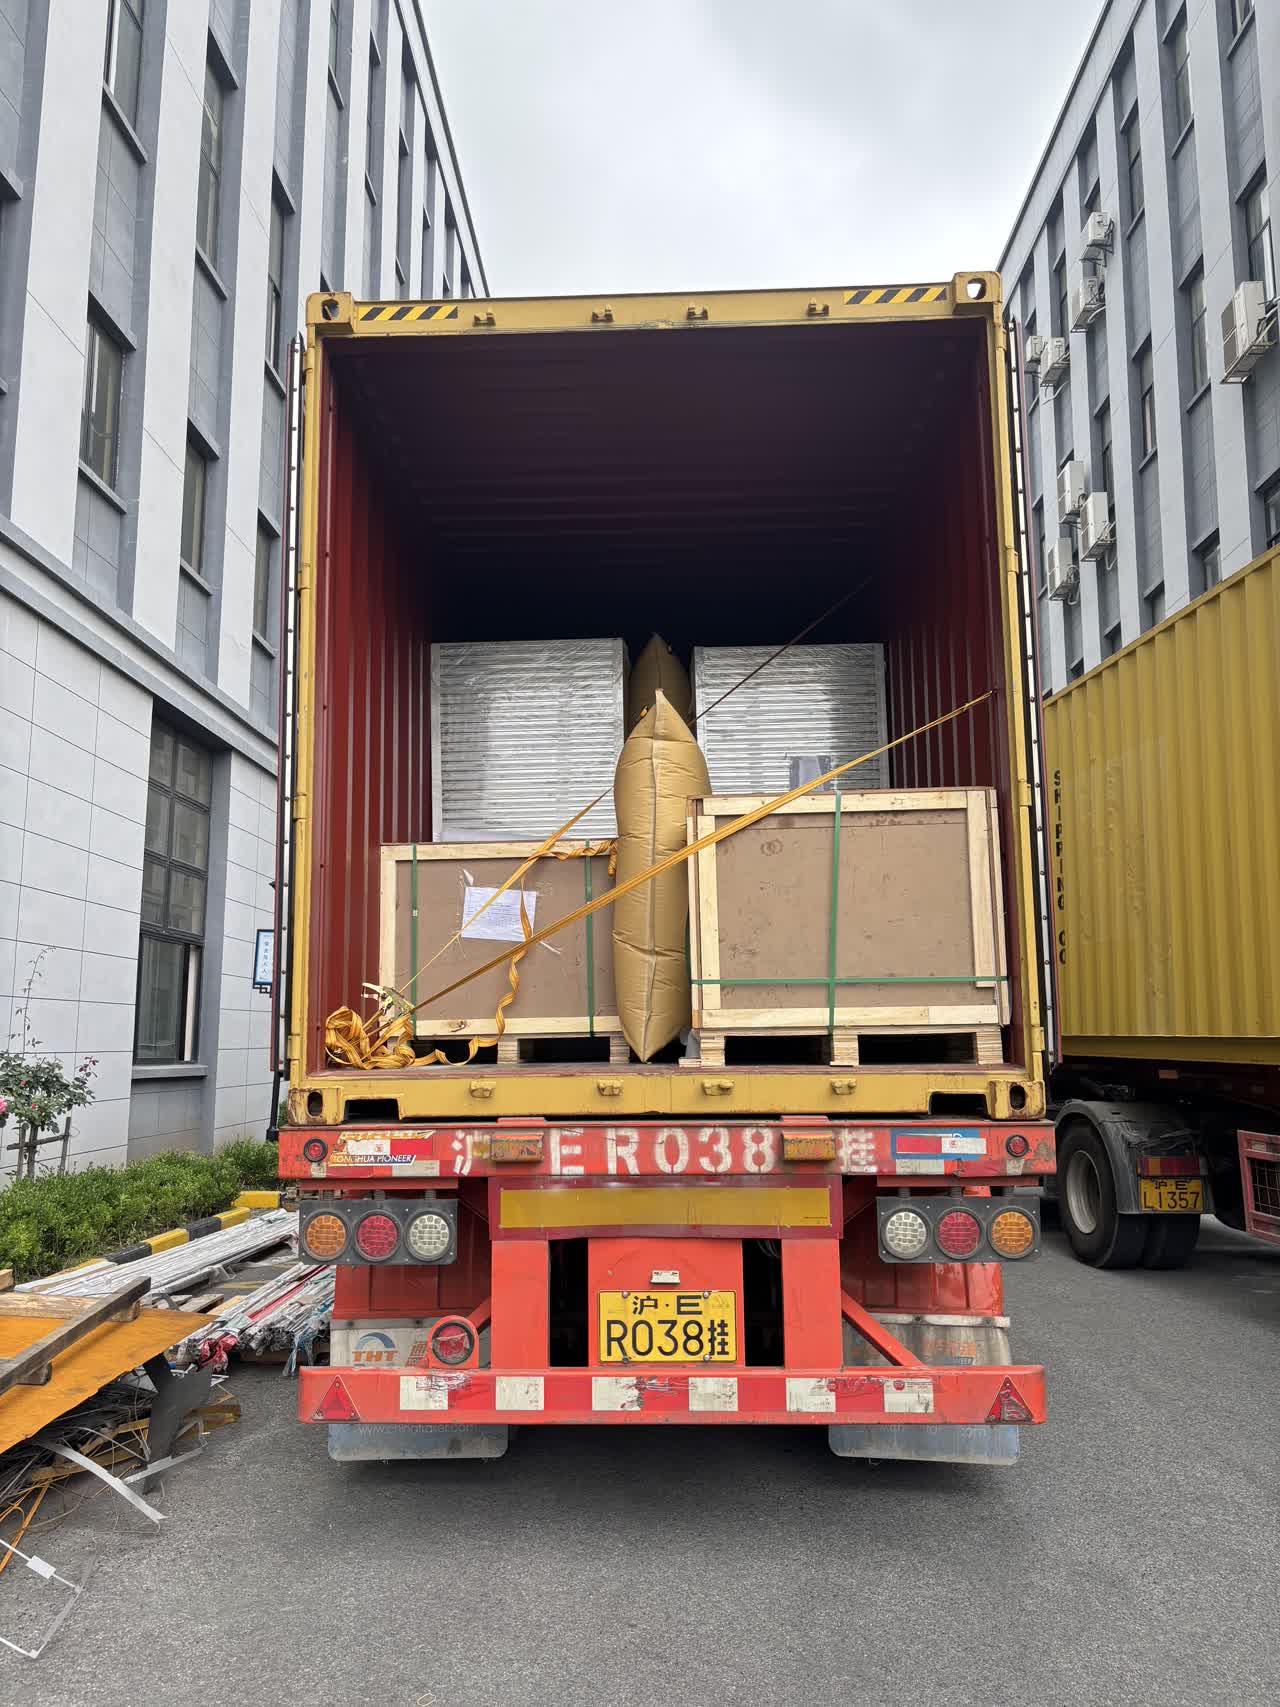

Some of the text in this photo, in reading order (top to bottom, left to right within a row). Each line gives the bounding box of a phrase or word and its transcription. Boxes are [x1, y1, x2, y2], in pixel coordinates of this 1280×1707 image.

[376, 1154, 411, 1163] PIONEER
[1144, 1191, 1200, 1209] L1357
[606, 1319, 730, 1359] R038挂
[352, 1350, 399, 1362] THT
